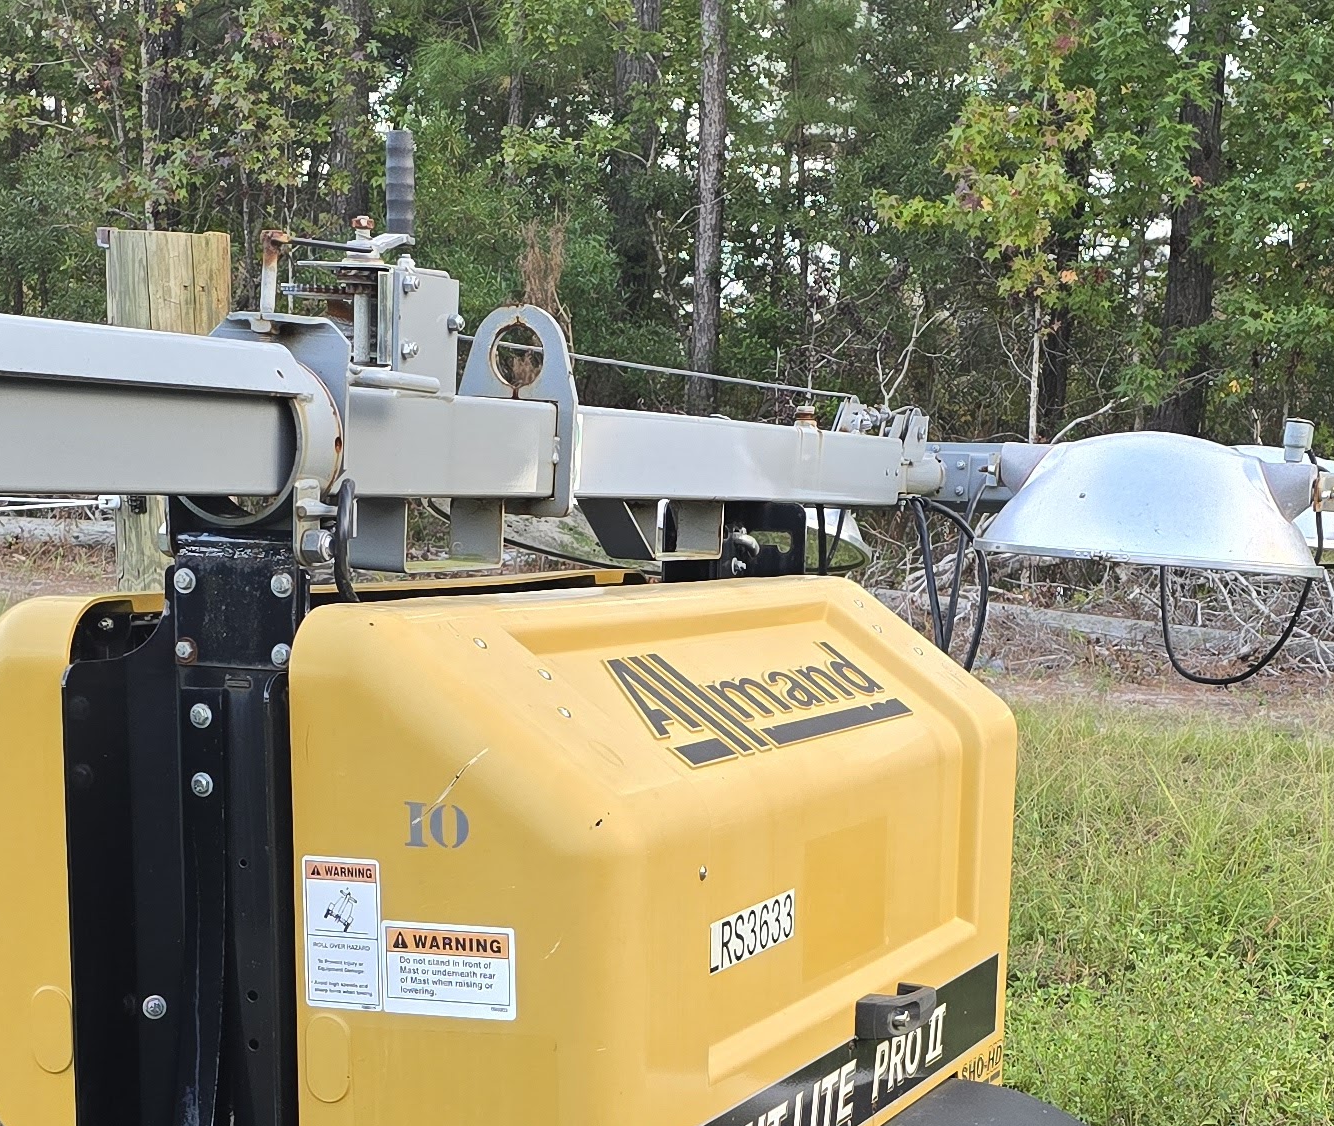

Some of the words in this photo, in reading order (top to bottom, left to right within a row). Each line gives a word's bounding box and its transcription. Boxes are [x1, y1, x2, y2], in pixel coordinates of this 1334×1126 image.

[603, 641, 885, 754] Allmand
[404, 801, 469, 849] 10
[324, 866, 373, 879] WARNING
[710, 893, 793, 974] LRS3633
[347, 944, 371, 952] HAZARD
[412, 934, 502, 954] WARNING
[399, 956, 411, 964] Do
[413, 957, 426, 965] not
[428, 958, 450, 966] stand
[452, 959, 459, 967] in
[462, 960, 481, 969] front
[399, 966, 419, 975] Mast
[432, 968, 477, 979] underneath
[400, 976, 408, 984] of
[411, 976, 429, 985] Mast
[432, 978, 453, 987] when
[455, 981, 482, 991] raising
[485, 982, 493, 990] or
[401, 986, 437, 997] lowering.
[870, 1027, 923, 1104] PRO
